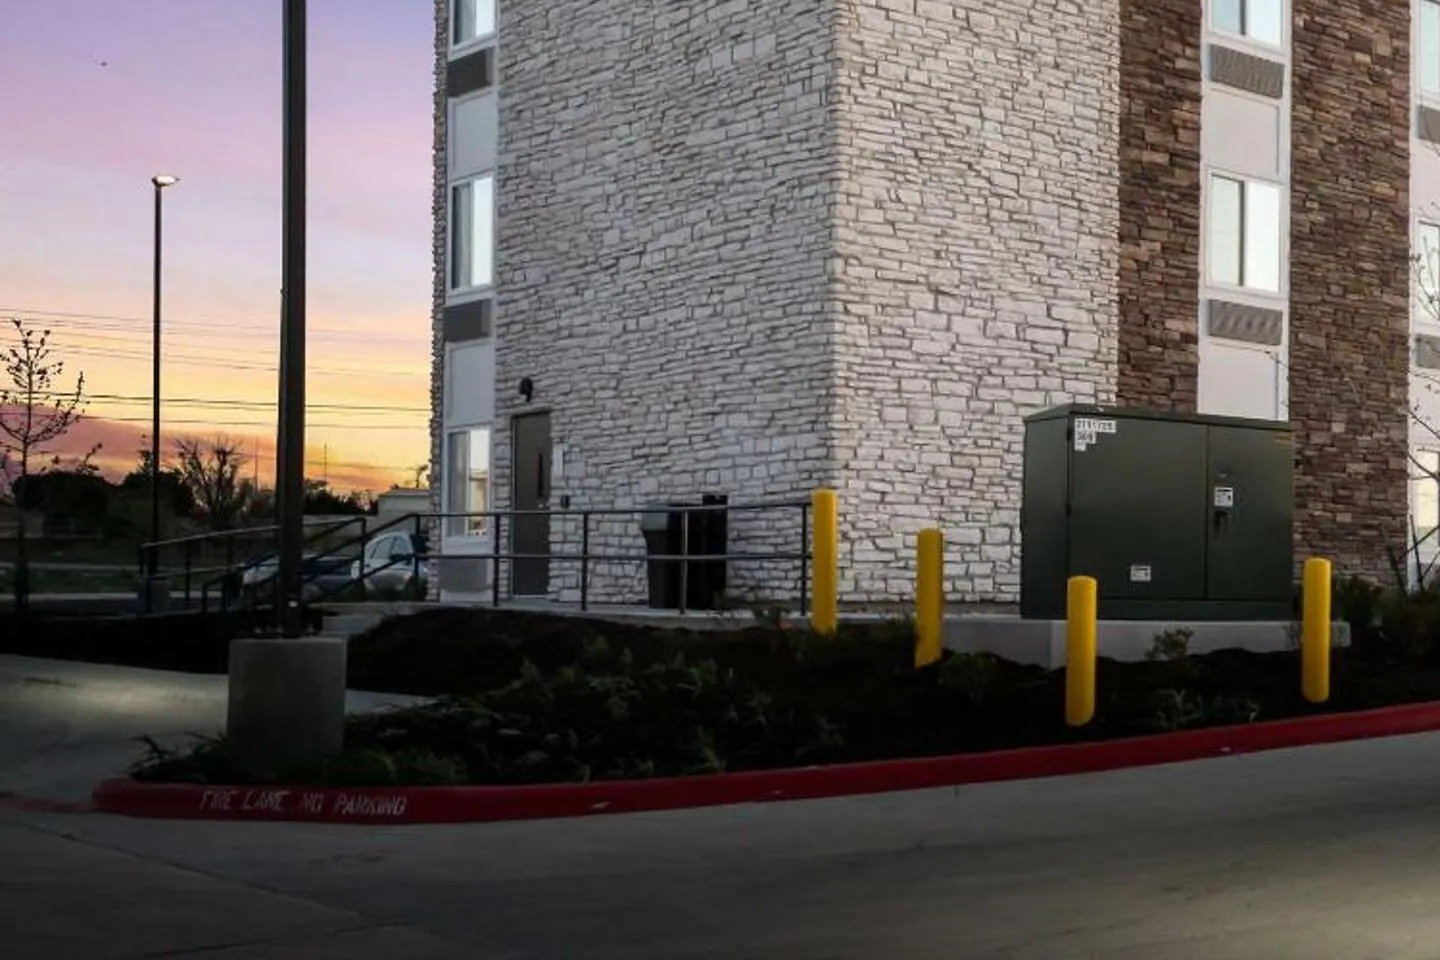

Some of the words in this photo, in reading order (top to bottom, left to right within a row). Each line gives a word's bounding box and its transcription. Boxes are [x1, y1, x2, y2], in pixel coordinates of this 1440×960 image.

[199, 790, 238, 811] FIRE
[241, 789, 291, 811] LANE
[333, 793, 408, 816] PARKING
